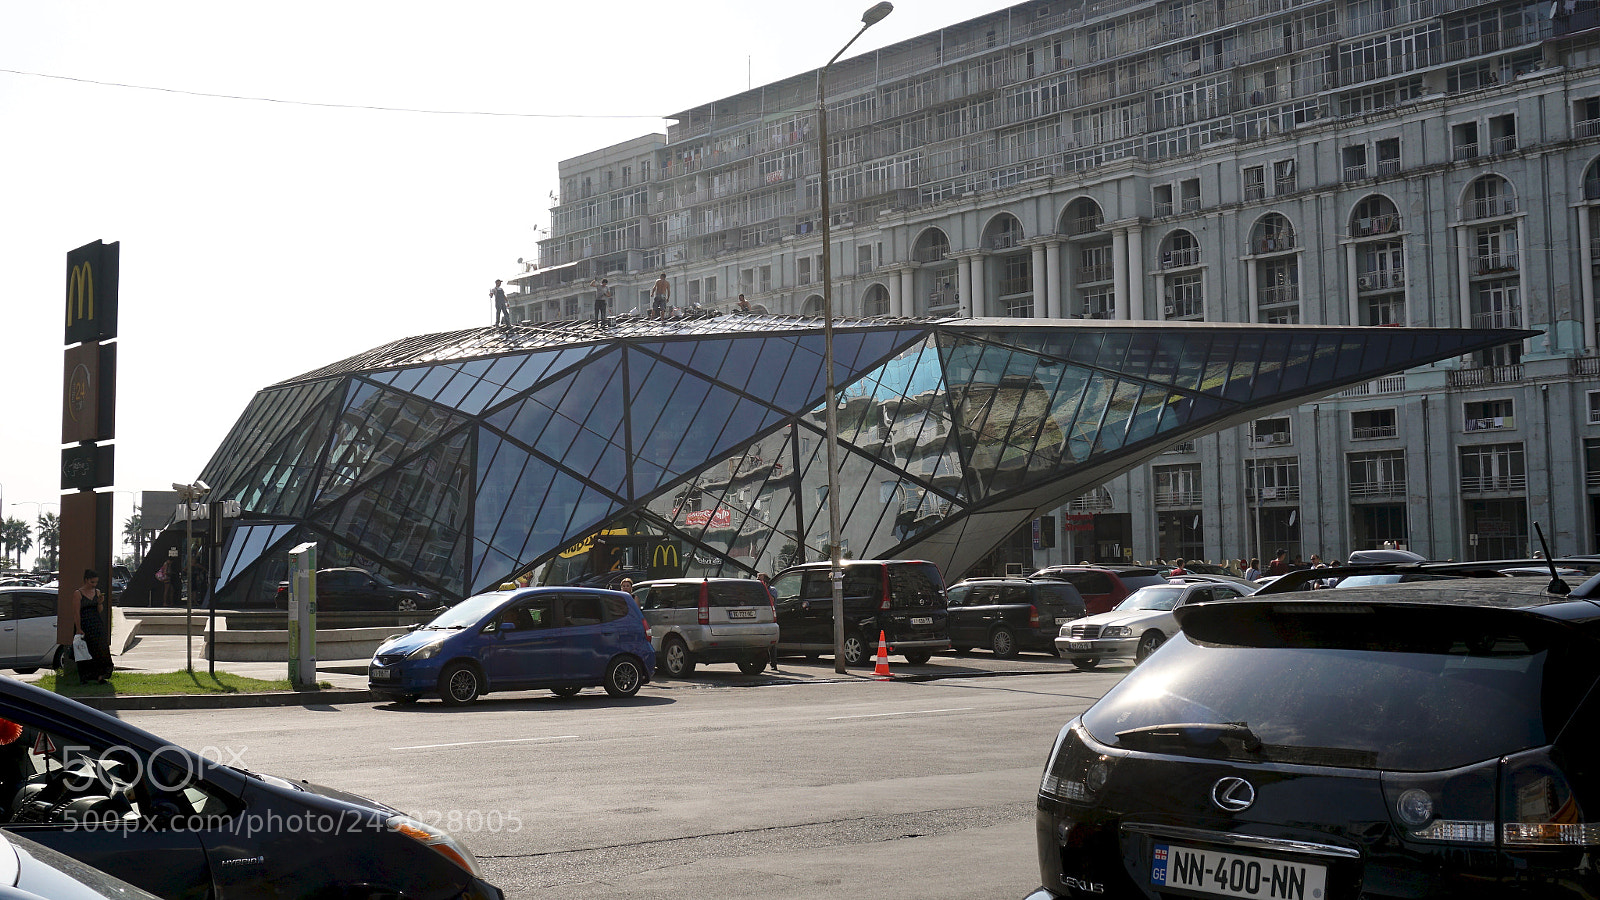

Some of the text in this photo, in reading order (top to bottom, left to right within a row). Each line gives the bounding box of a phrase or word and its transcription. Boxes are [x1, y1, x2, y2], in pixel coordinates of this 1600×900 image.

[221, 857, 257, 867] HYBRID
[1153, 867, 1166, 880] GE
[1172, 850, 1307, 900] NN-400-NN
[1059, 873, 1105, 894] LEXUS
